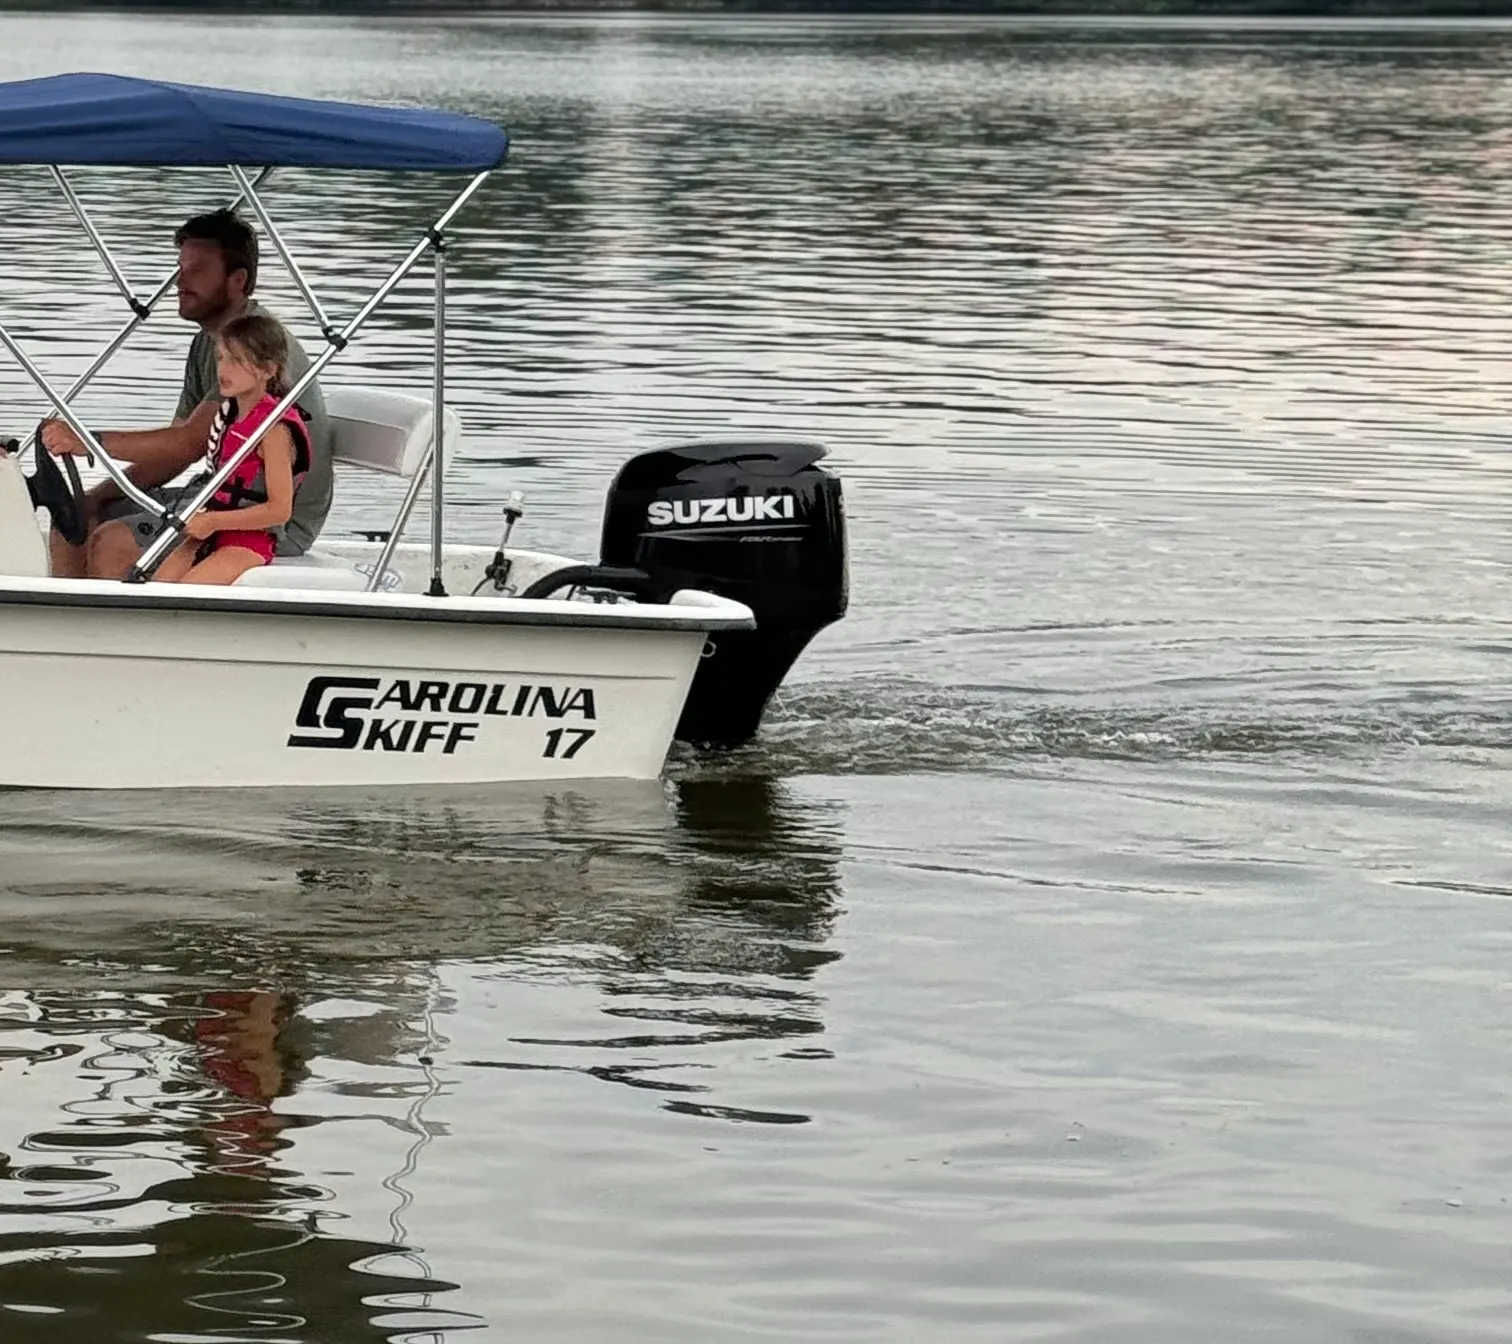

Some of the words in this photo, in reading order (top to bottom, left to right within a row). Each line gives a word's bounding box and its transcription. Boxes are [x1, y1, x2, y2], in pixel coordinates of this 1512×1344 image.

[647, 495, 795, 525] SUZUKI
[287, 697, 480, 755] SKIFF
[542, 728, 596, 759] 17
[296, 676, 597, 728] CAROLINA
